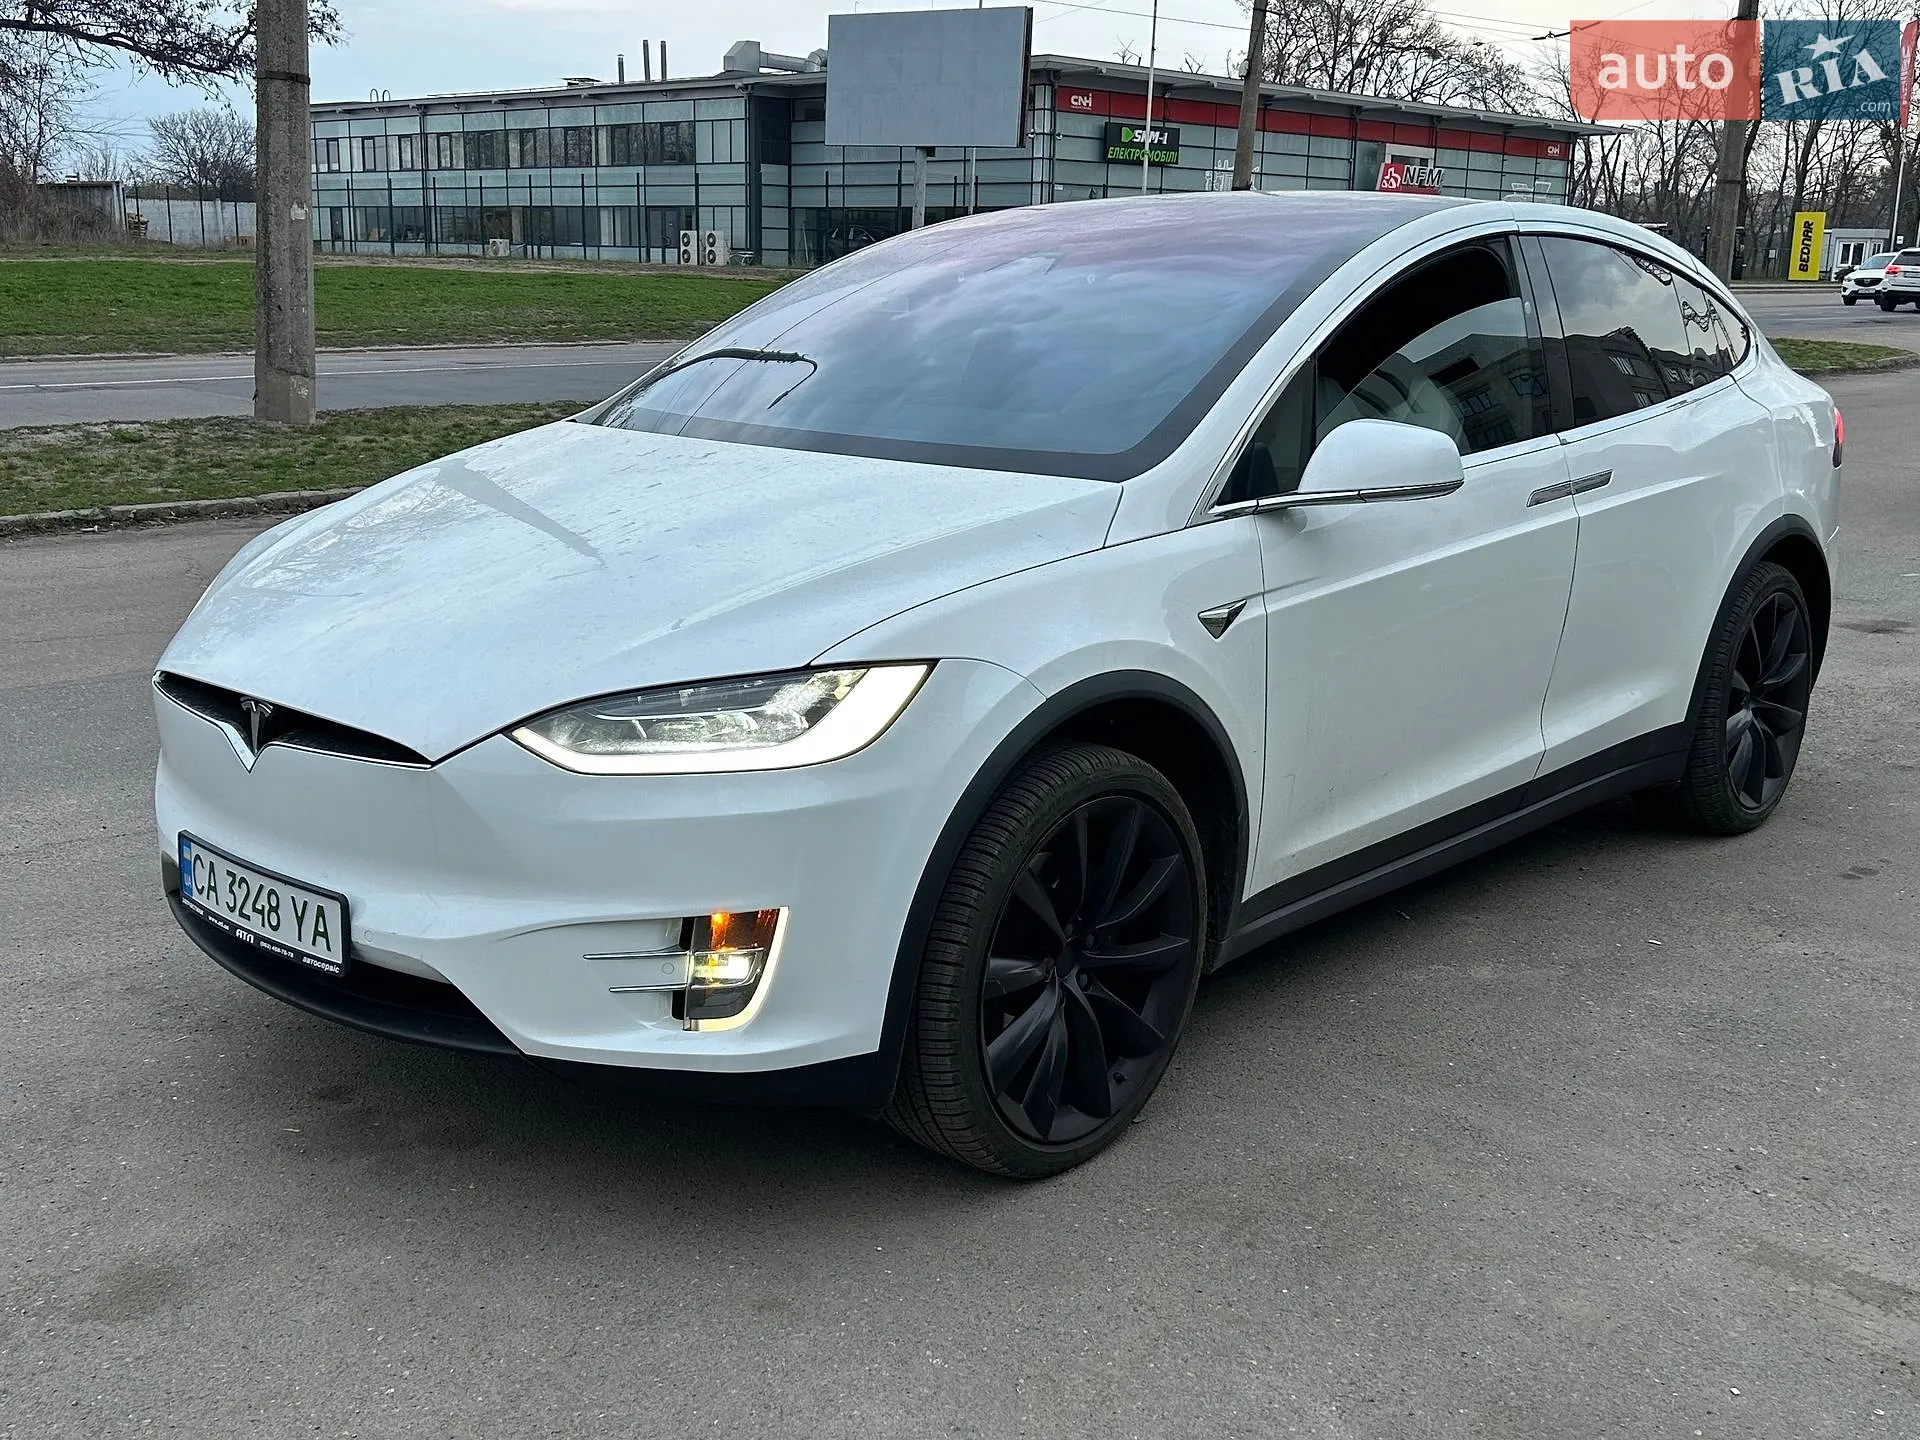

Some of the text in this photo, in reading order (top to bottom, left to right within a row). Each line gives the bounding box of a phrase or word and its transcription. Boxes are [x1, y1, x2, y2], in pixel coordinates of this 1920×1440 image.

[1402, 165, 1444, 187] NFM
[1798, 220, 1814, 273] BEDNAR
[193, 853, 332, 952] CA 3248 YA
